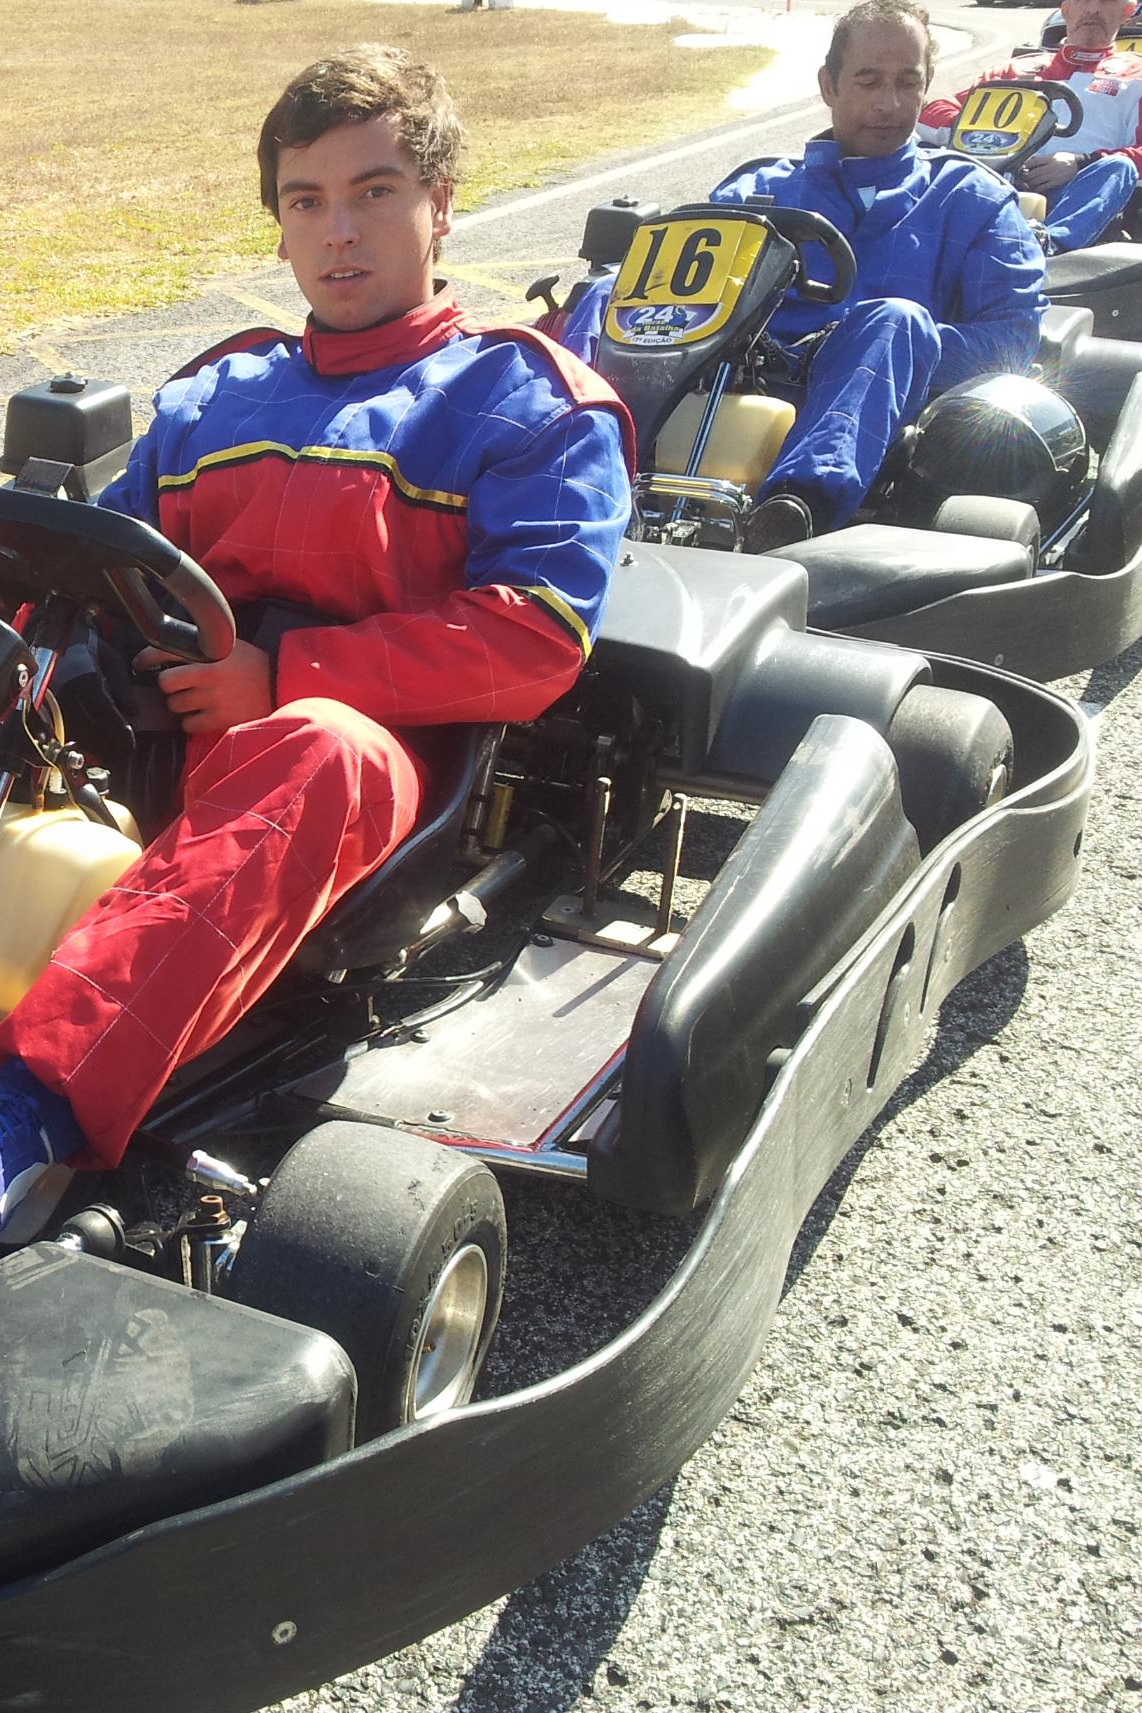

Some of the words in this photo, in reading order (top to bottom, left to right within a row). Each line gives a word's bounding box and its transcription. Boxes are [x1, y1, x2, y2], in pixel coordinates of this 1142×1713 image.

[969, 91, 1023, 129] 10
[623, 226, 722, 300] 16
[634, 305, 674, 324] 24
